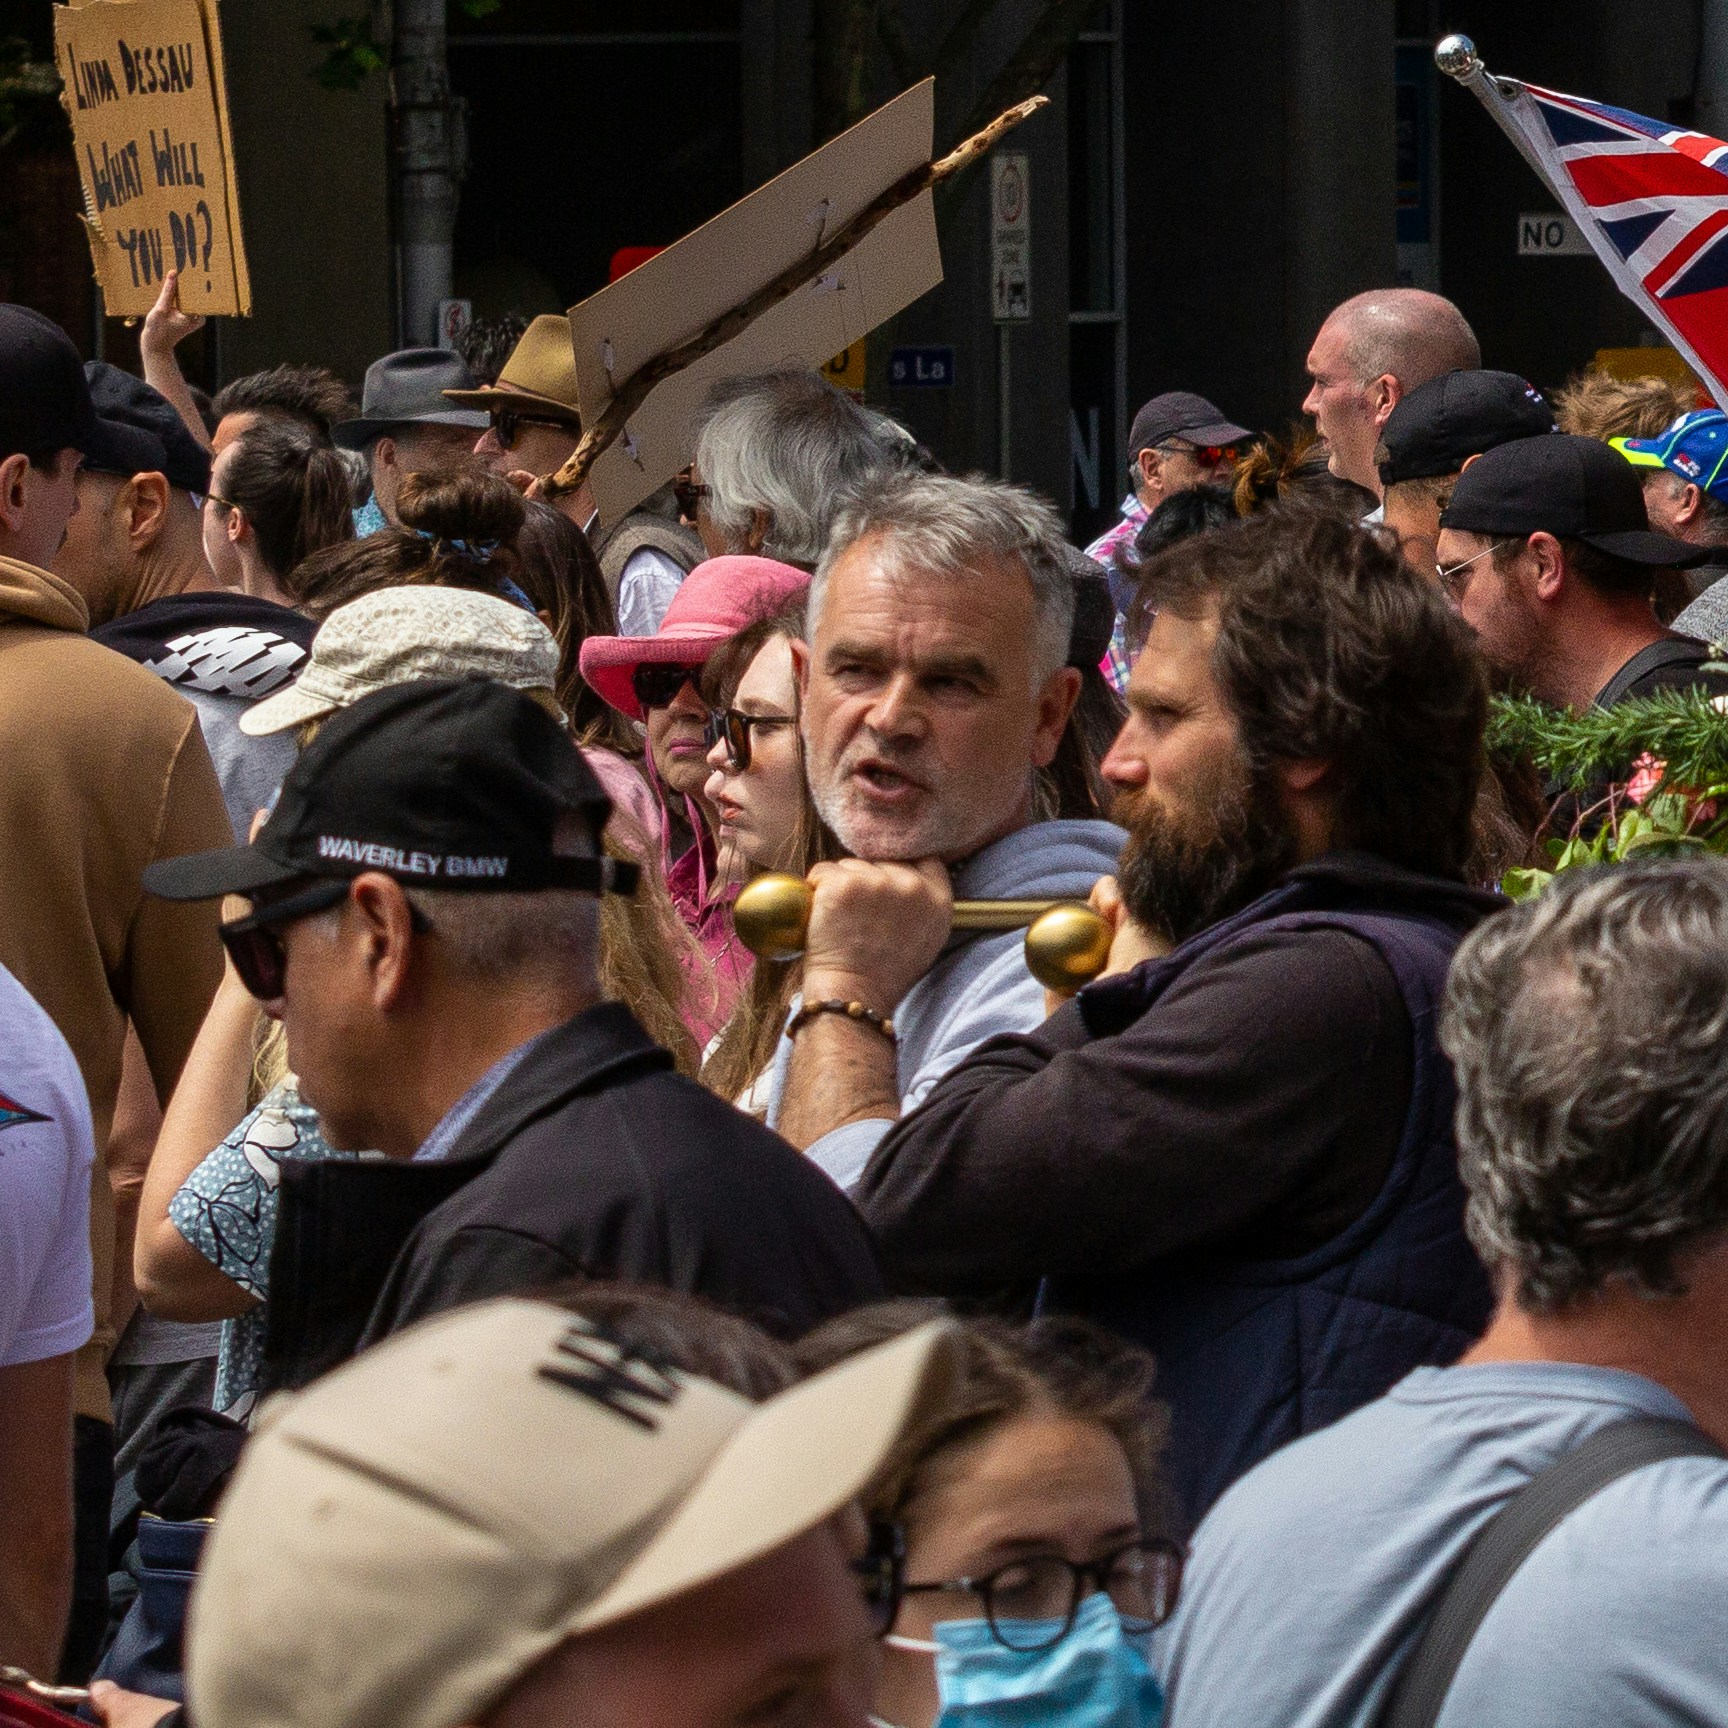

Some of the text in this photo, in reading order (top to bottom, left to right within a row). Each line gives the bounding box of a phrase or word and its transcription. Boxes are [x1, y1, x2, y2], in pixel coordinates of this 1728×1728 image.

[118, 39, 194, 95] DESSAU
[86, 127, 206, 213] WHAT WILL
[116, 228, 164, 288] YOU
[1523, 220, 1564, 249] NO
[318, 835, 509, 878] WAVERLEY BMW
